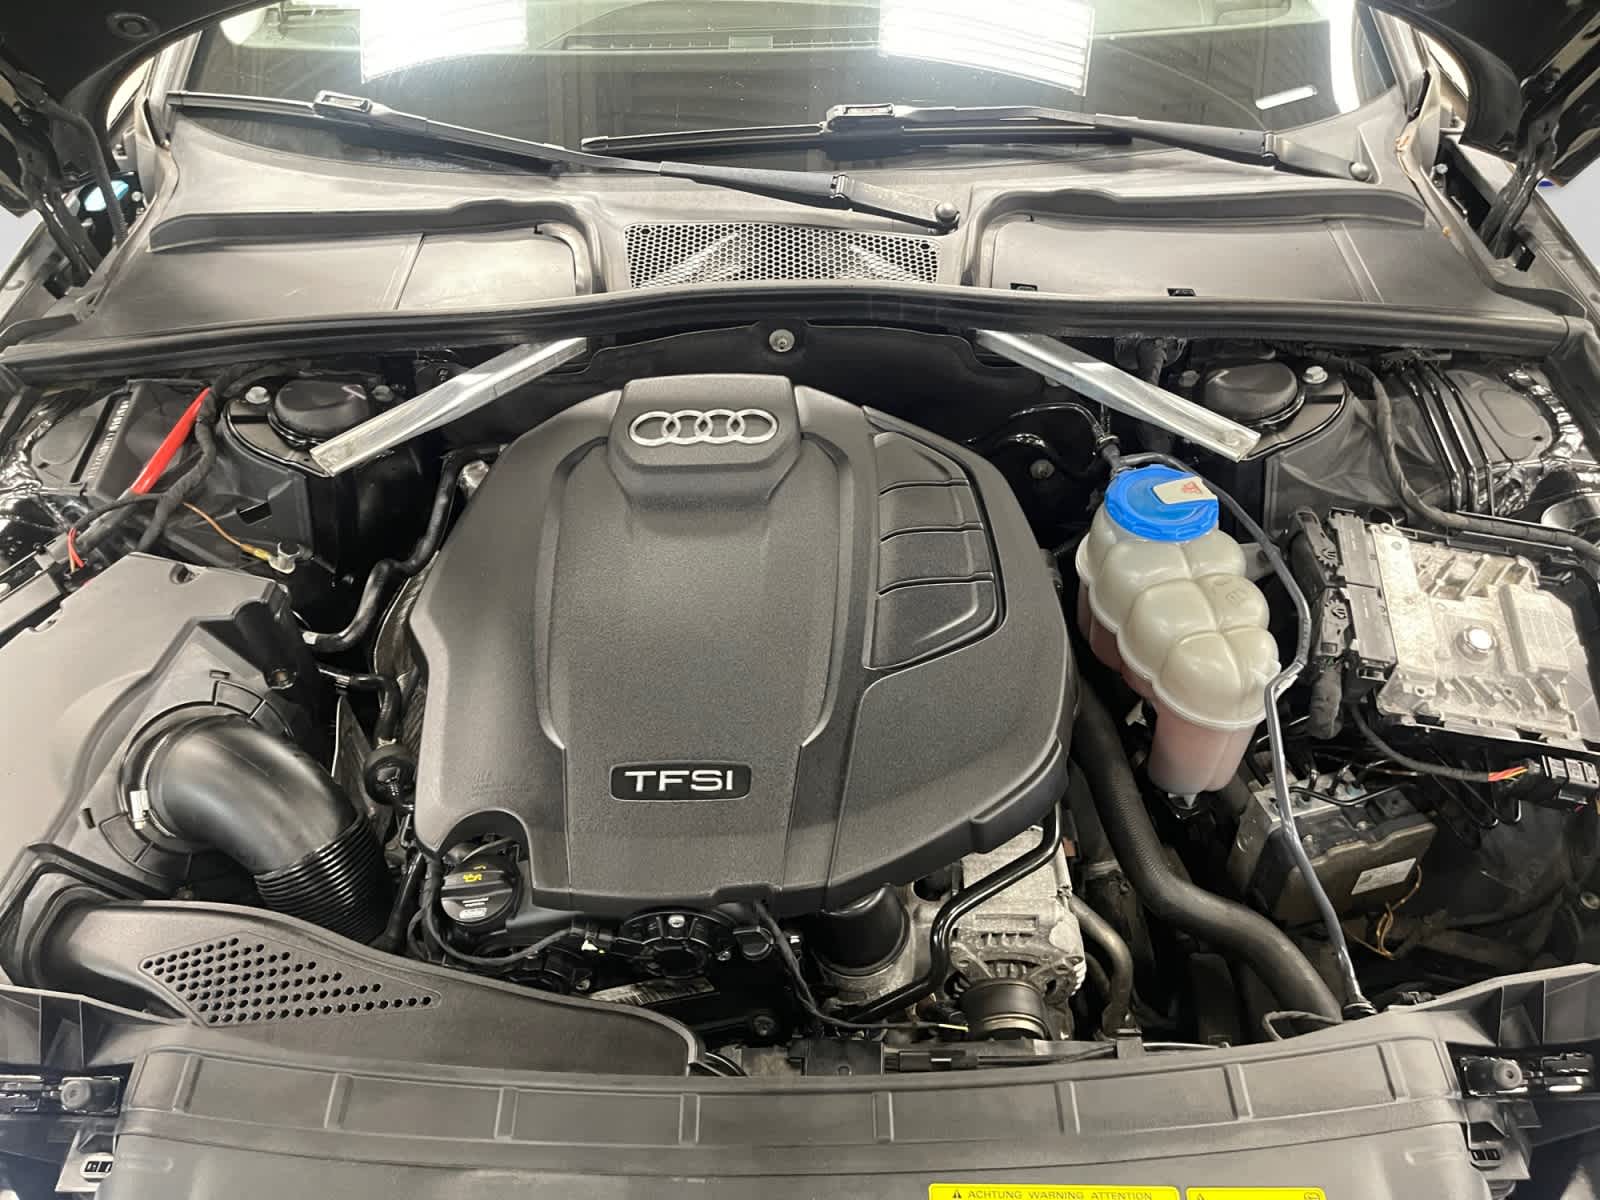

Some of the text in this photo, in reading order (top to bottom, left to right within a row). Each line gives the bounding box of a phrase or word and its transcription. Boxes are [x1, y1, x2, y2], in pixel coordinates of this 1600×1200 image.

[625, 770, 733, 792] TFSI
[968, 1190, 1152, 1200] ACHTUNG WARNING ATTENTION
